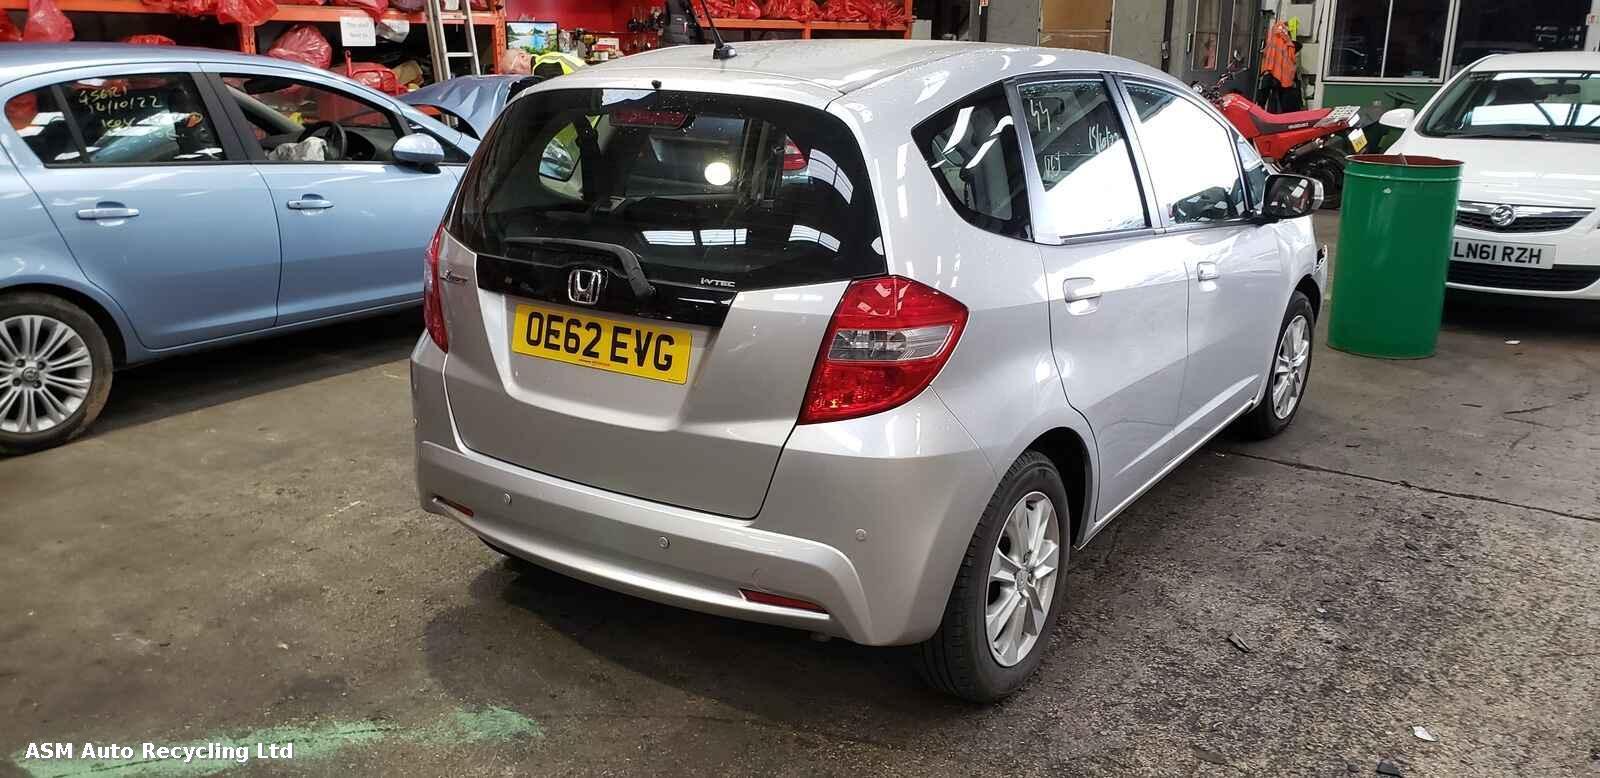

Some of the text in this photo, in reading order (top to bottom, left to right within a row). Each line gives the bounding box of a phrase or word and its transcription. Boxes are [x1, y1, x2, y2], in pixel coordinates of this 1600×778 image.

[1453, 242, 1542, 264] LN61 RZH
[526, 311, 675, 372] OE62 EVG
